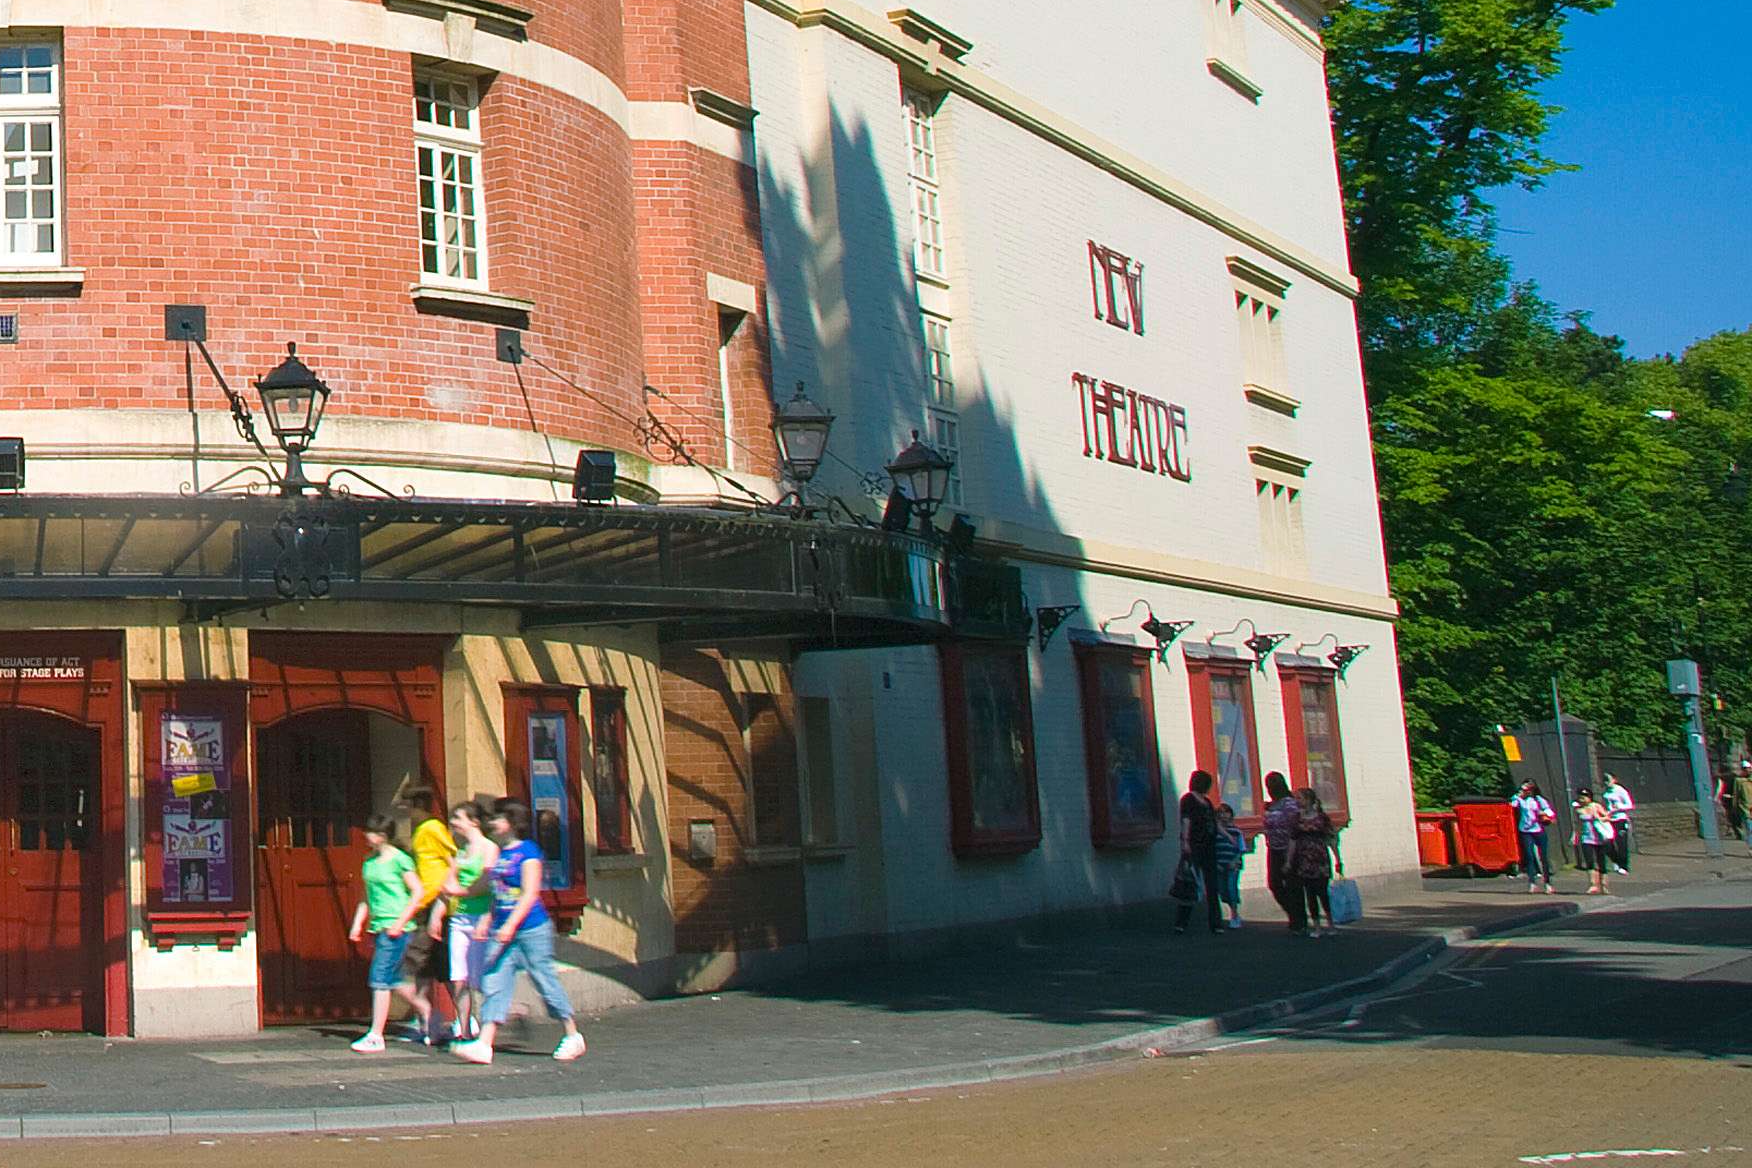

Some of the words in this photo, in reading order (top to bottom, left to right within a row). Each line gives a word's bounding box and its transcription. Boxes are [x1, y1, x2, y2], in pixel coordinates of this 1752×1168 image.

[1086, 239, 1145, 337] NEW
[1072, 371, 1192, 484] THEATRE
[20, 668, 50, 678] STAGE
[54, 667, 84, 678] PLAYS
[45, 657, 58, 667] OF
[61, 657, 81, 667] ACT
[165, 739, 220, 762] FAME
[167, 832, 222, 854] FAME
